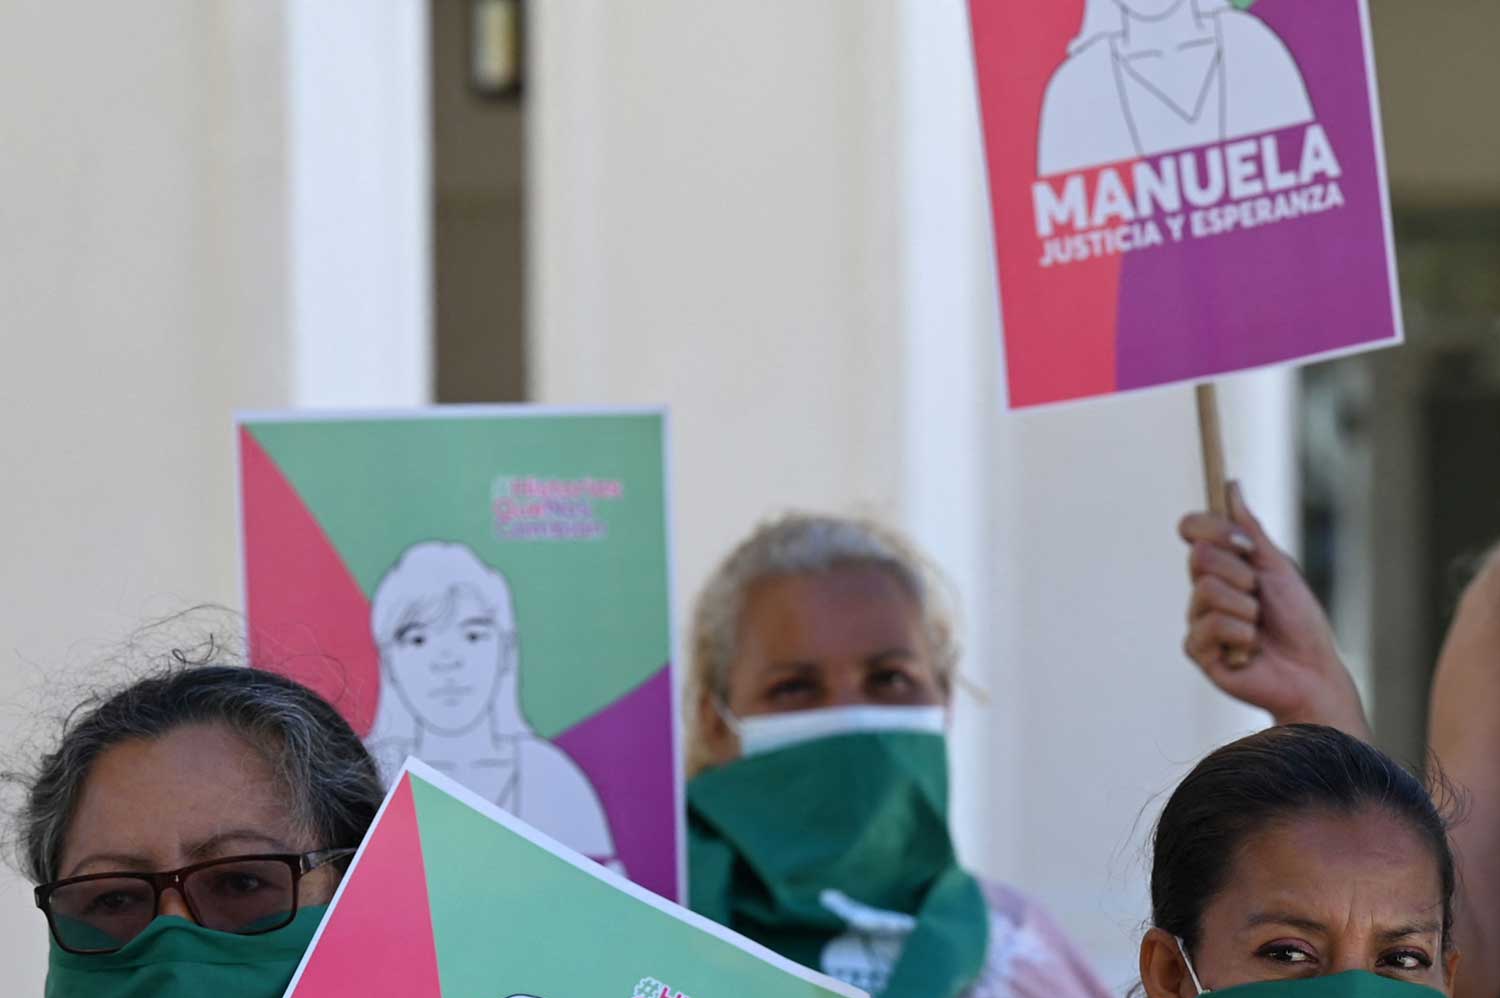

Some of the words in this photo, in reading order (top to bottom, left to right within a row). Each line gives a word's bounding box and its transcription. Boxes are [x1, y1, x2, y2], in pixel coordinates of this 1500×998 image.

[1032, 123, 1341, 238] MANUELA
[1039, 219, 1163, 267] JUSTICIA
[1166, 214, 1187, 241] Y
[1191, 183, 1345, 238] ESPERANZA
